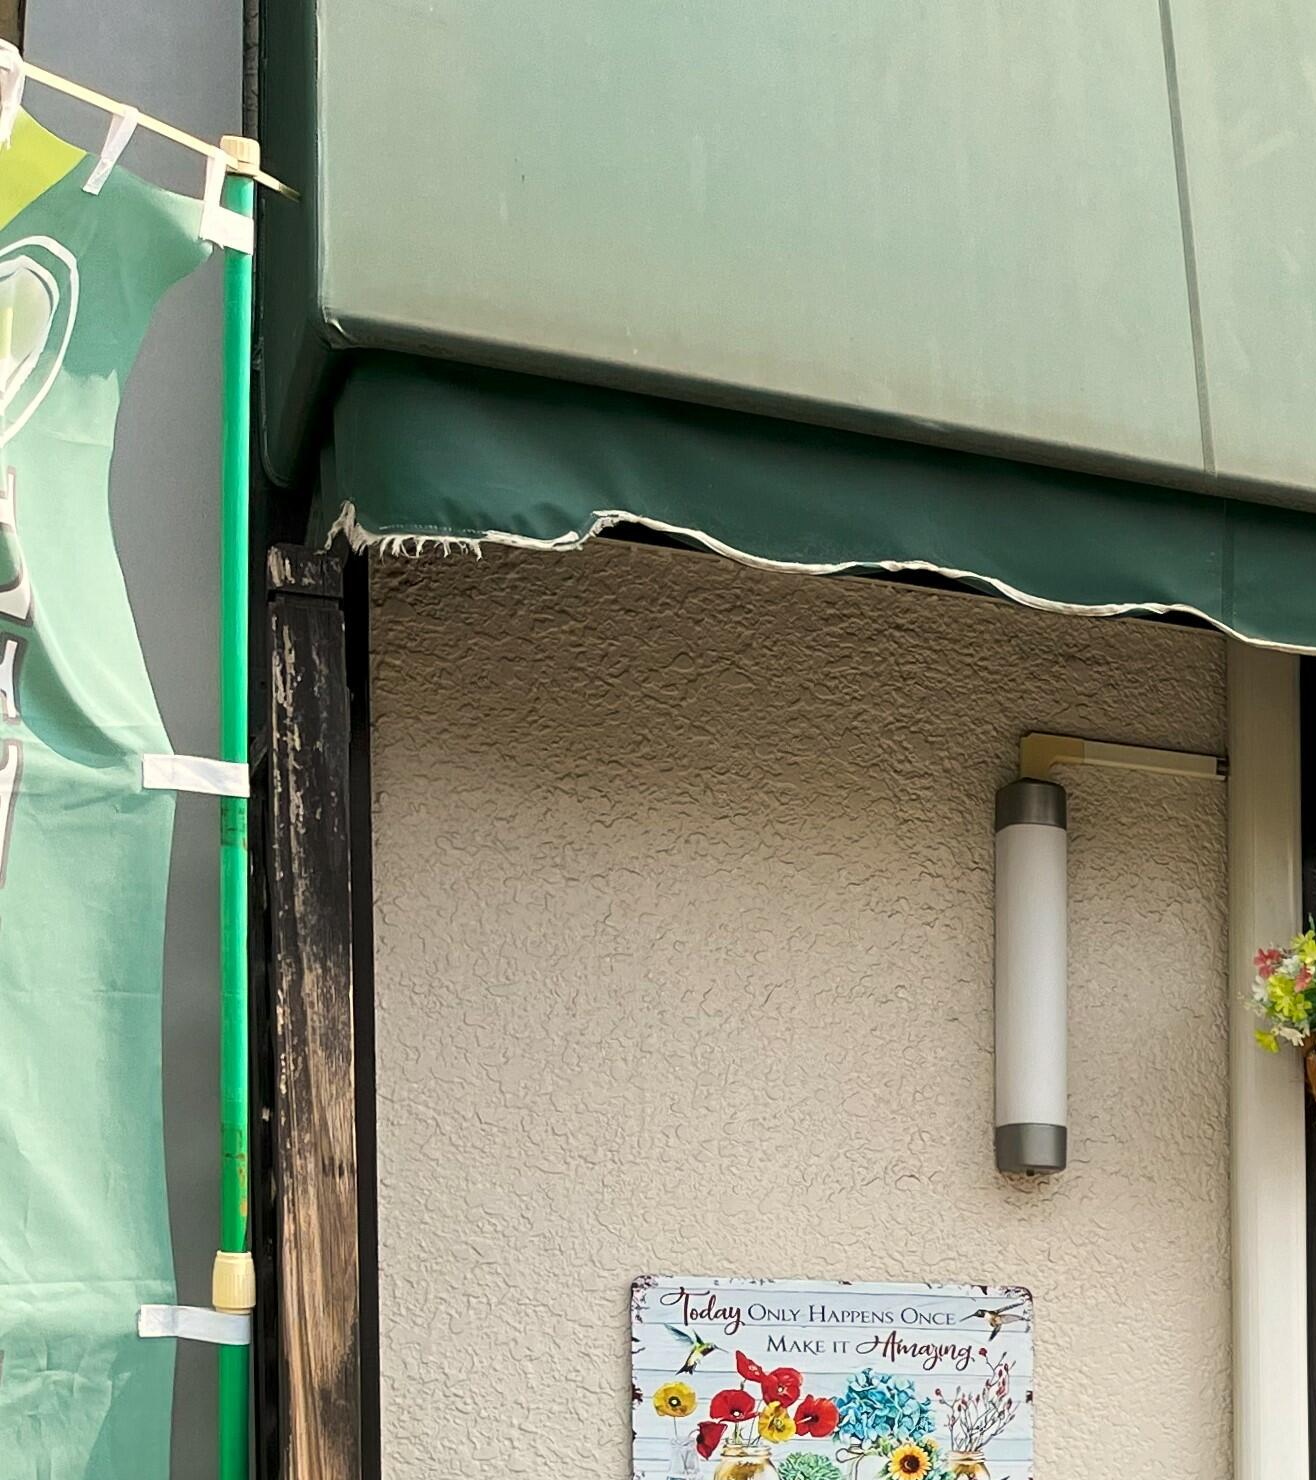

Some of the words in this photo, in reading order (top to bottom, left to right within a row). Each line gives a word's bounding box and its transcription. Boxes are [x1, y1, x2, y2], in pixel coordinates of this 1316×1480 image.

[660, 1285, 742, 1336] Today
[747, 1307, 800, 1323] ONLY
[808, 1306, 894, 1324] HAPPENS
[900, 1308, 957, 1325] ONCE
[766, 1335, 825, 1354] MAKE
[855, 1330, 975, 1371] Amazing
